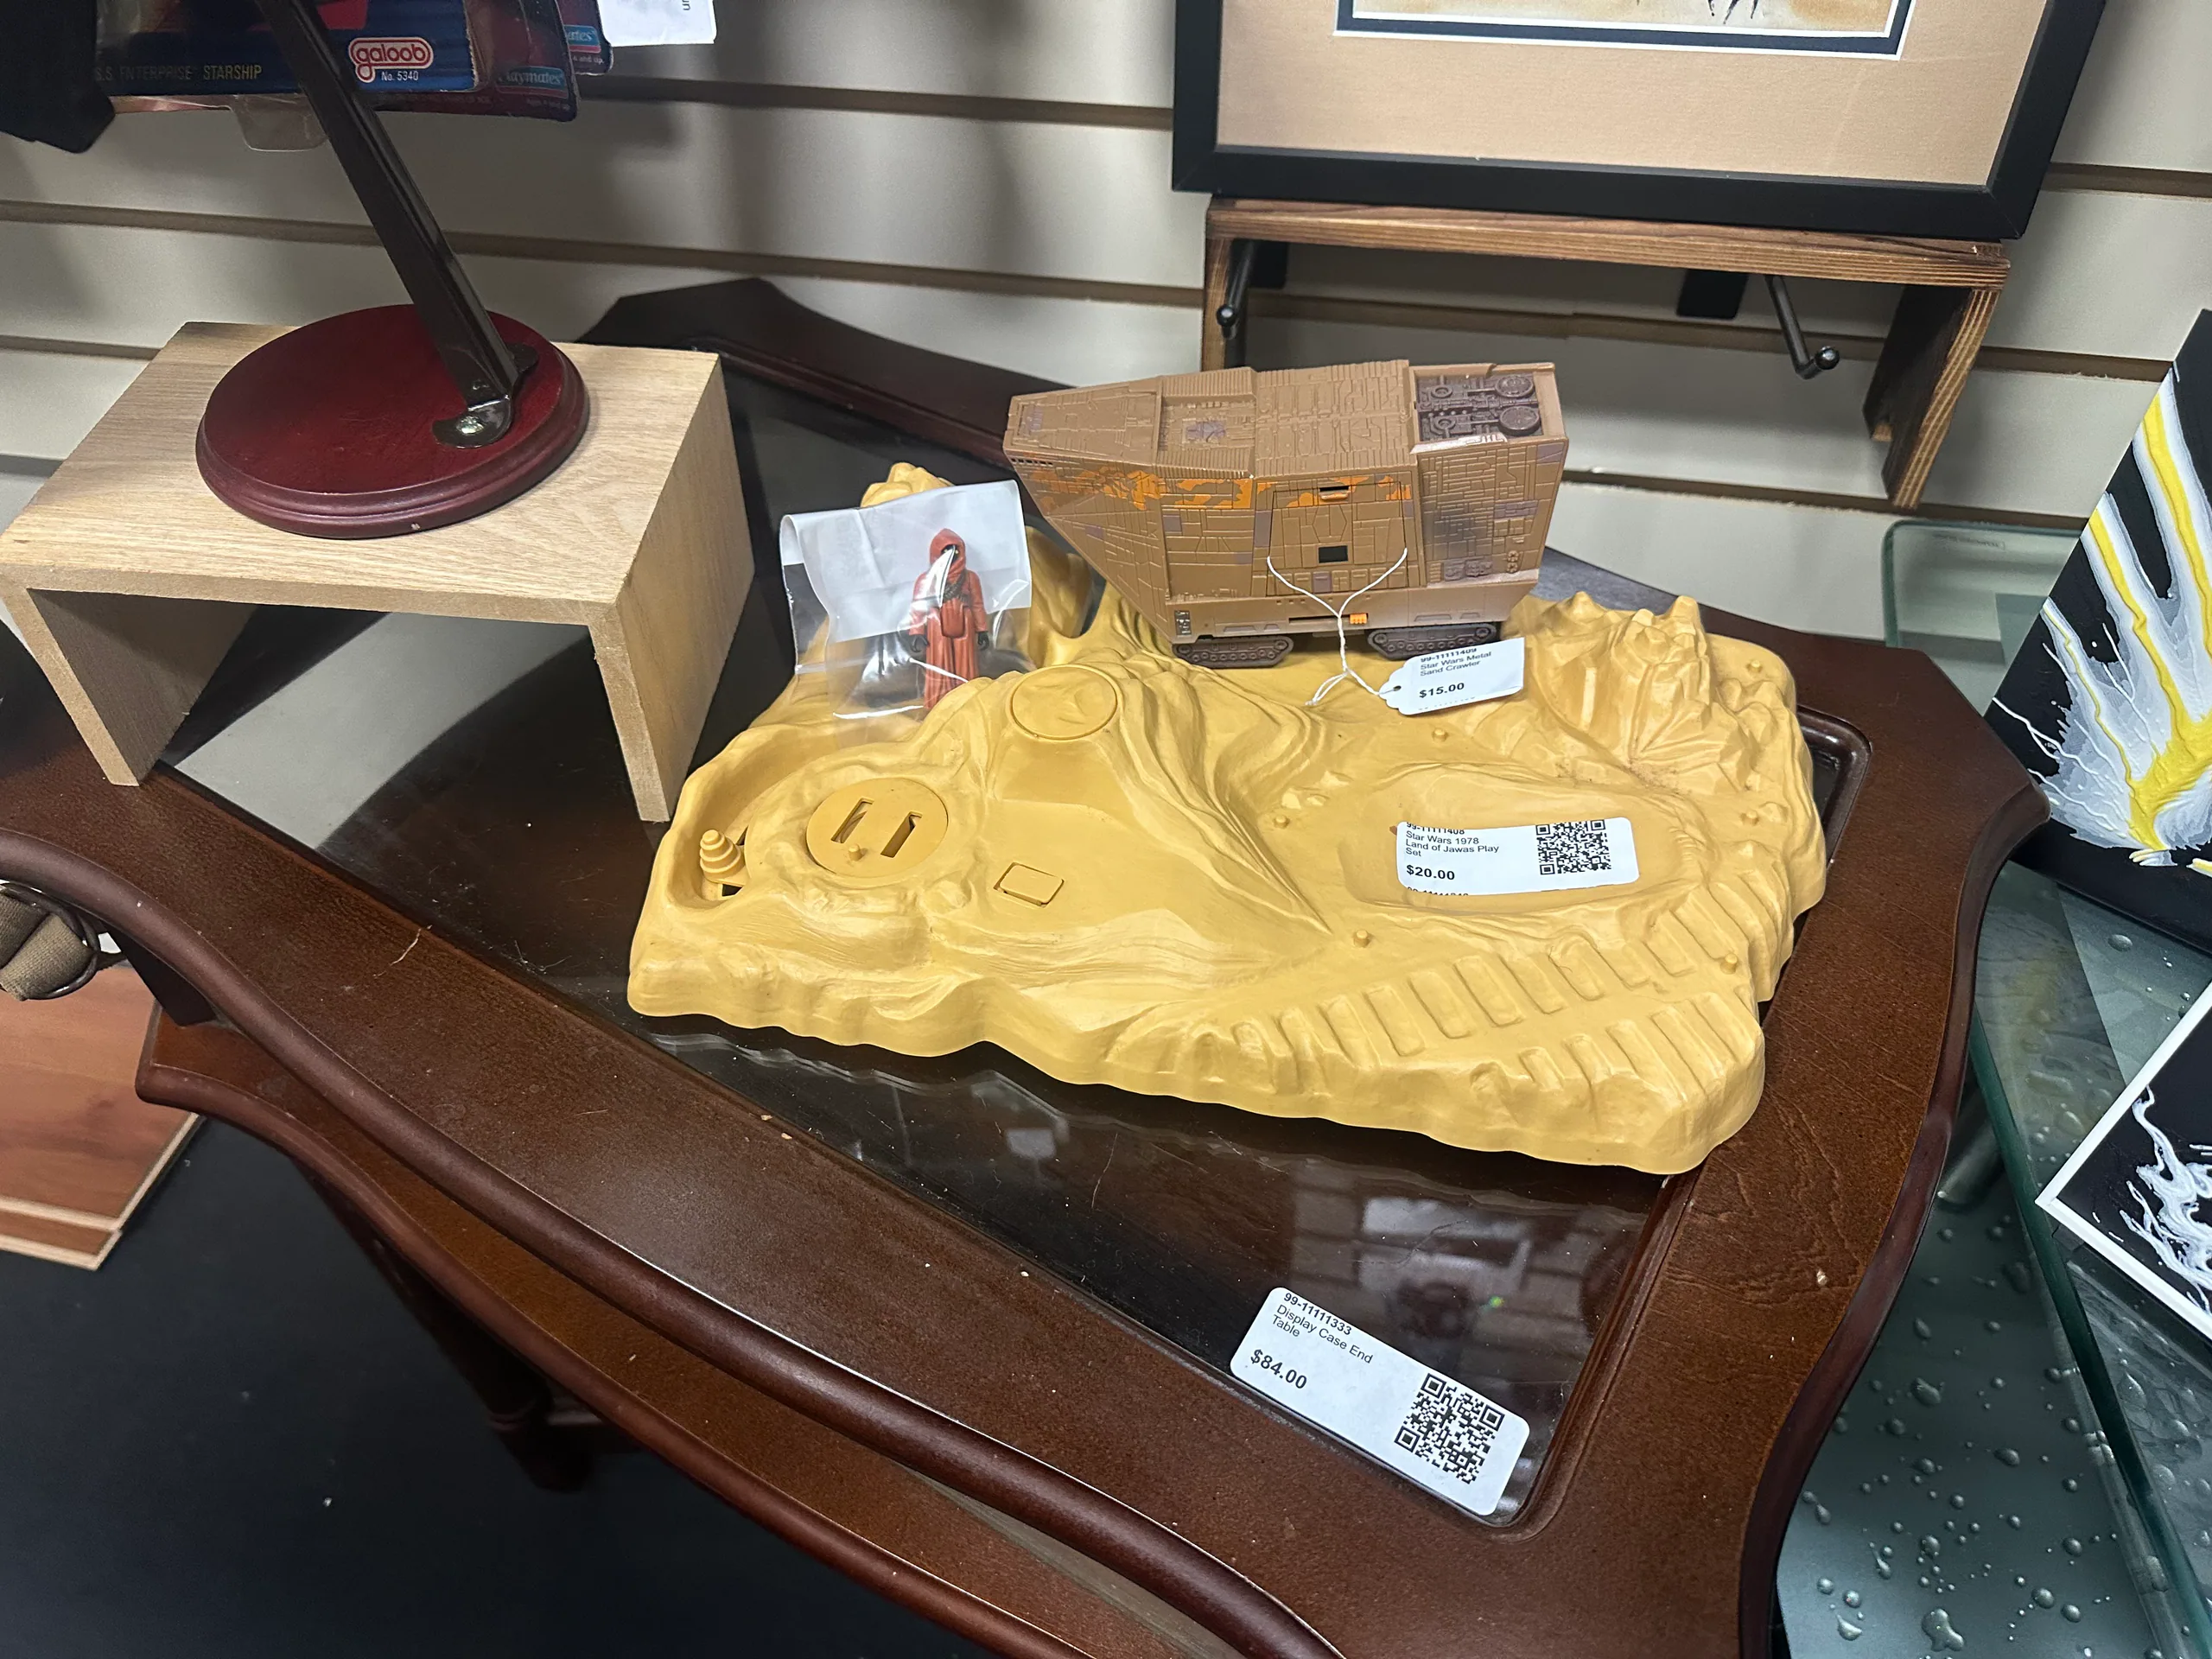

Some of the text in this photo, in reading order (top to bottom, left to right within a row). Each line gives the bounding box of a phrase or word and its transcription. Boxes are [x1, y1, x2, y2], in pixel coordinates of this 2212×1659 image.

[355, 43, 426, 81] galoob
[203, 65, 263, 80] STARSHIP
[381, 70, 419, 81] No. 5340
[1440, 657, 1465, 666] Wars
[1466, 652, 1492, 661] Metal
[1420, 660, 1481, 677] Sand Crawler
[1419, 682, 1465, 699] $15.00
[1405, 838, 1429, 850] Land
[1406, 830, 1479, 845] Star Wars 1978
[1405, 847, 1422, 857] Set
[1406, 864, 1456, 880] $20.00
[1283, 1292, 1352, 1335] 99-11111333
[1272, 1313, 1300, 1338] Table
[1276, 1304, 1374, 1363] Display Case End
[1250, 1349, 1307, 1389] $84.00
